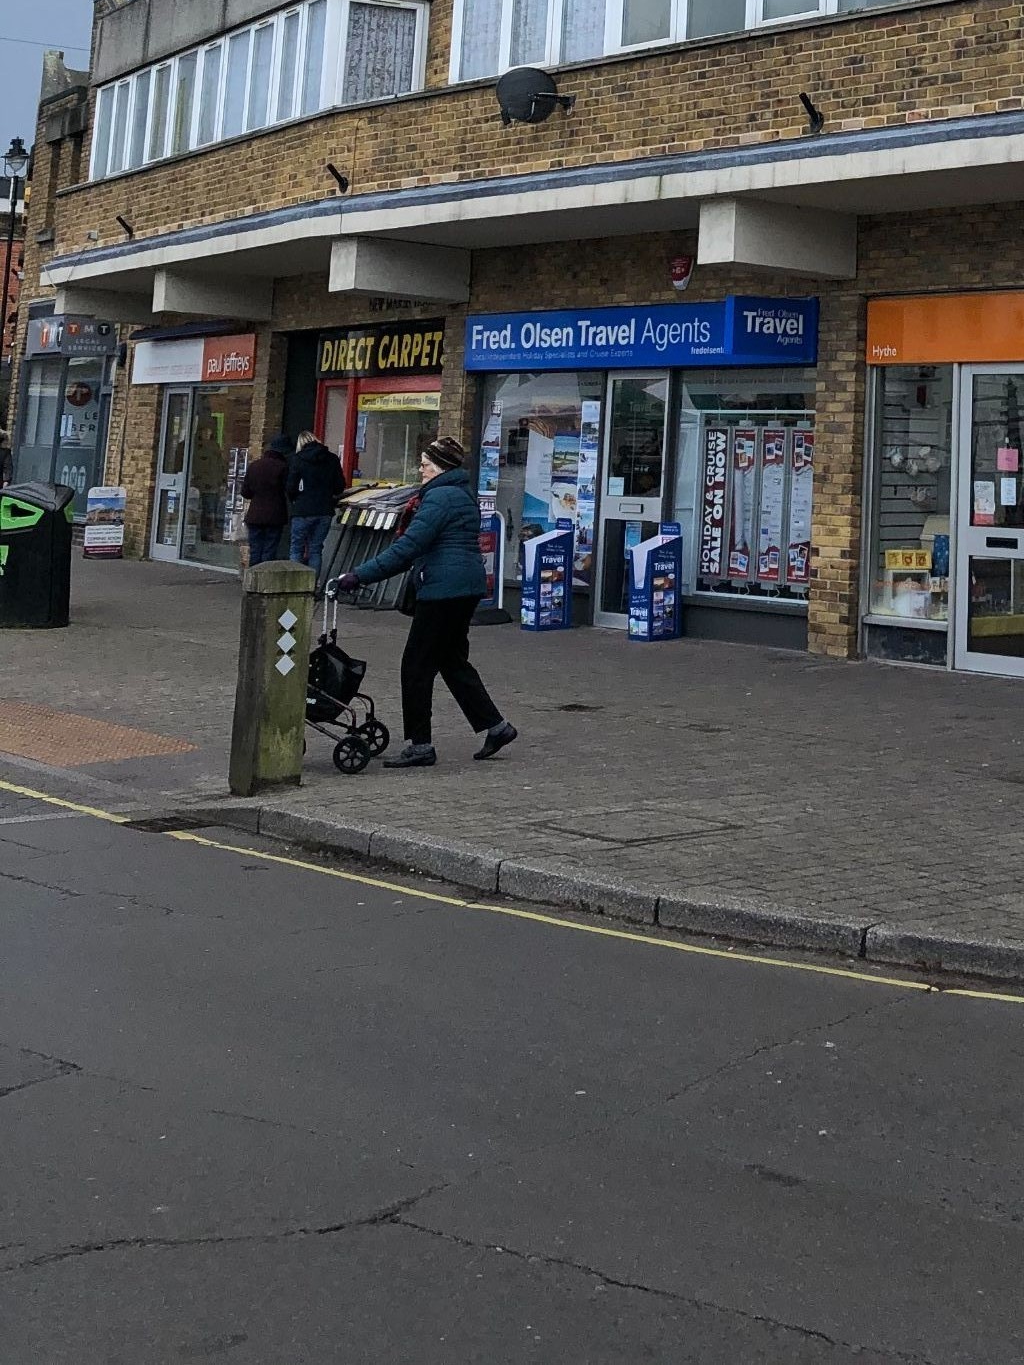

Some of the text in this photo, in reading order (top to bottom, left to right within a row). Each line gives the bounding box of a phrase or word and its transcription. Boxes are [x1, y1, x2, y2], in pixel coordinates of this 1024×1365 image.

[743, 310, 804, 335] Travel
[471, 317, 711, 352] Fred. Olsen Travel Agents
[776, 335, 803, 346] Agents
[320, 331, 444, 372] DIRECT CARPET
[589, 348, 609, 358] Cruise
[610, 348, 634, 358] Experts
[872, 344, 898, 360] Hythe
[206, 355, 222, 378] paul
[222, 351, 251, 377] jeffreys
[479, 501, 496, 511] SALE
[700, 431, 718, 573] HOLIDAY & CRUISE
[708, 431, 728, 574] SALE ON NOW
[541, 554, 564, 564] Travel
[653, 561, 675, 572] Travel
